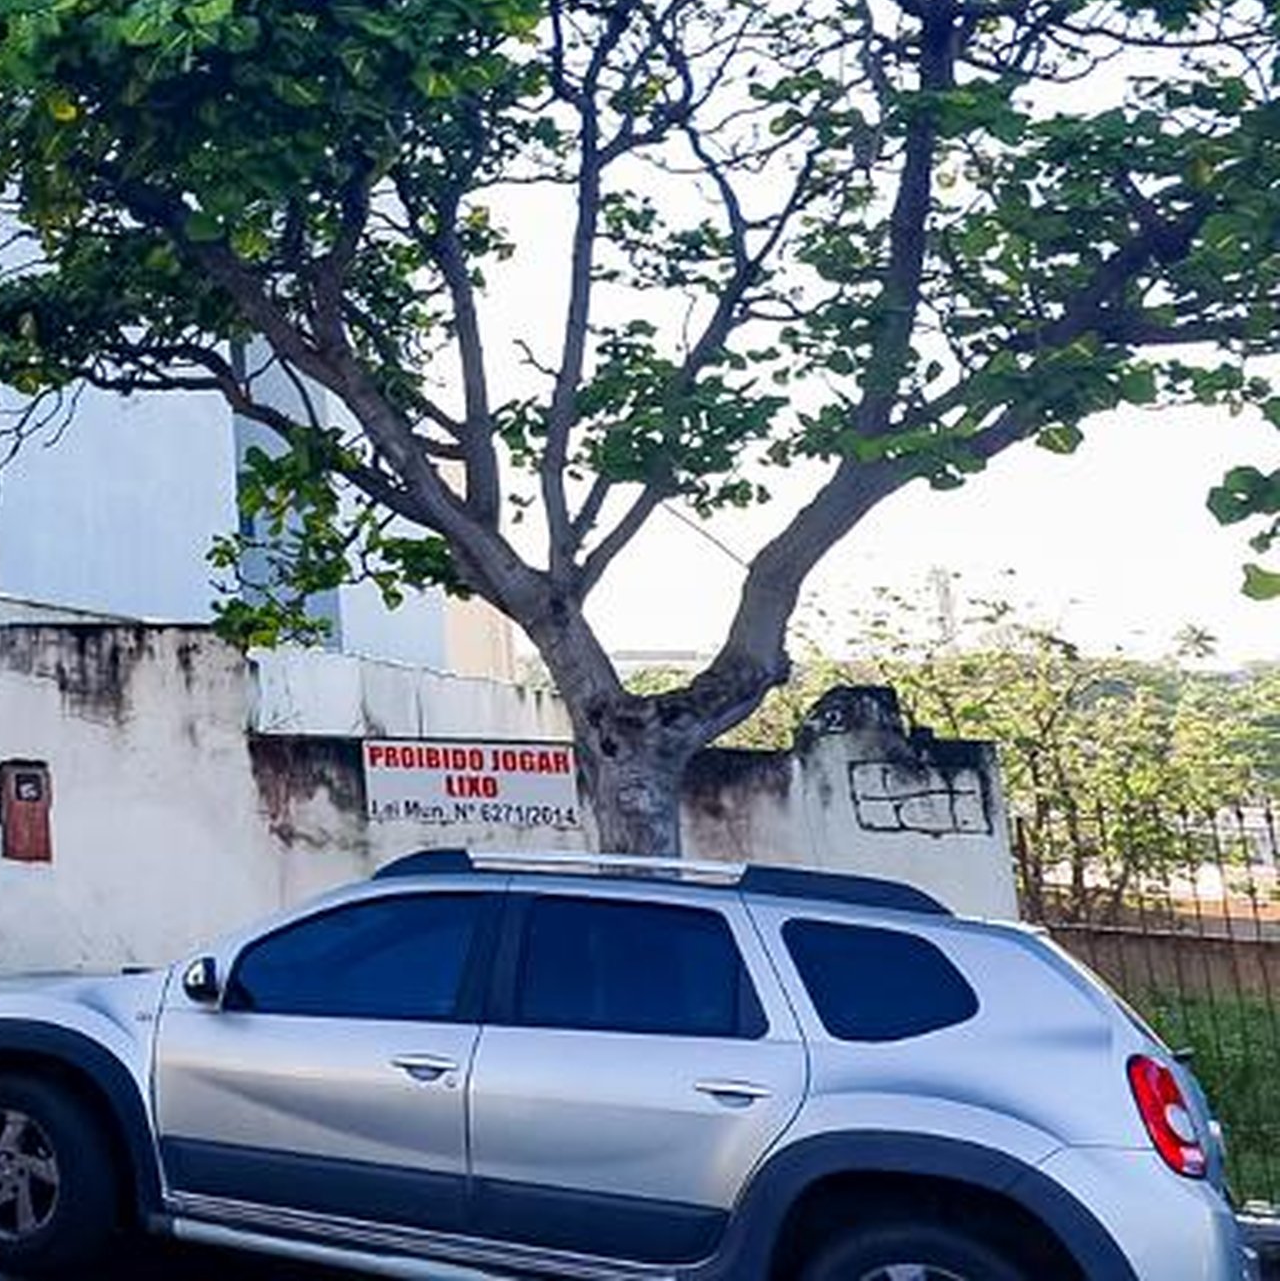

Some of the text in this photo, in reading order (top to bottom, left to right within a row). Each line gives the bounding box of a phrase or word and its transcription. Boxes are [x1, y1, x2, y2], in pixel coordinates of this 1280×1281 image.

[368, 746, 571, 774] PROIBIDO JOGAR
[445, 774, 499, 799] LIXO
